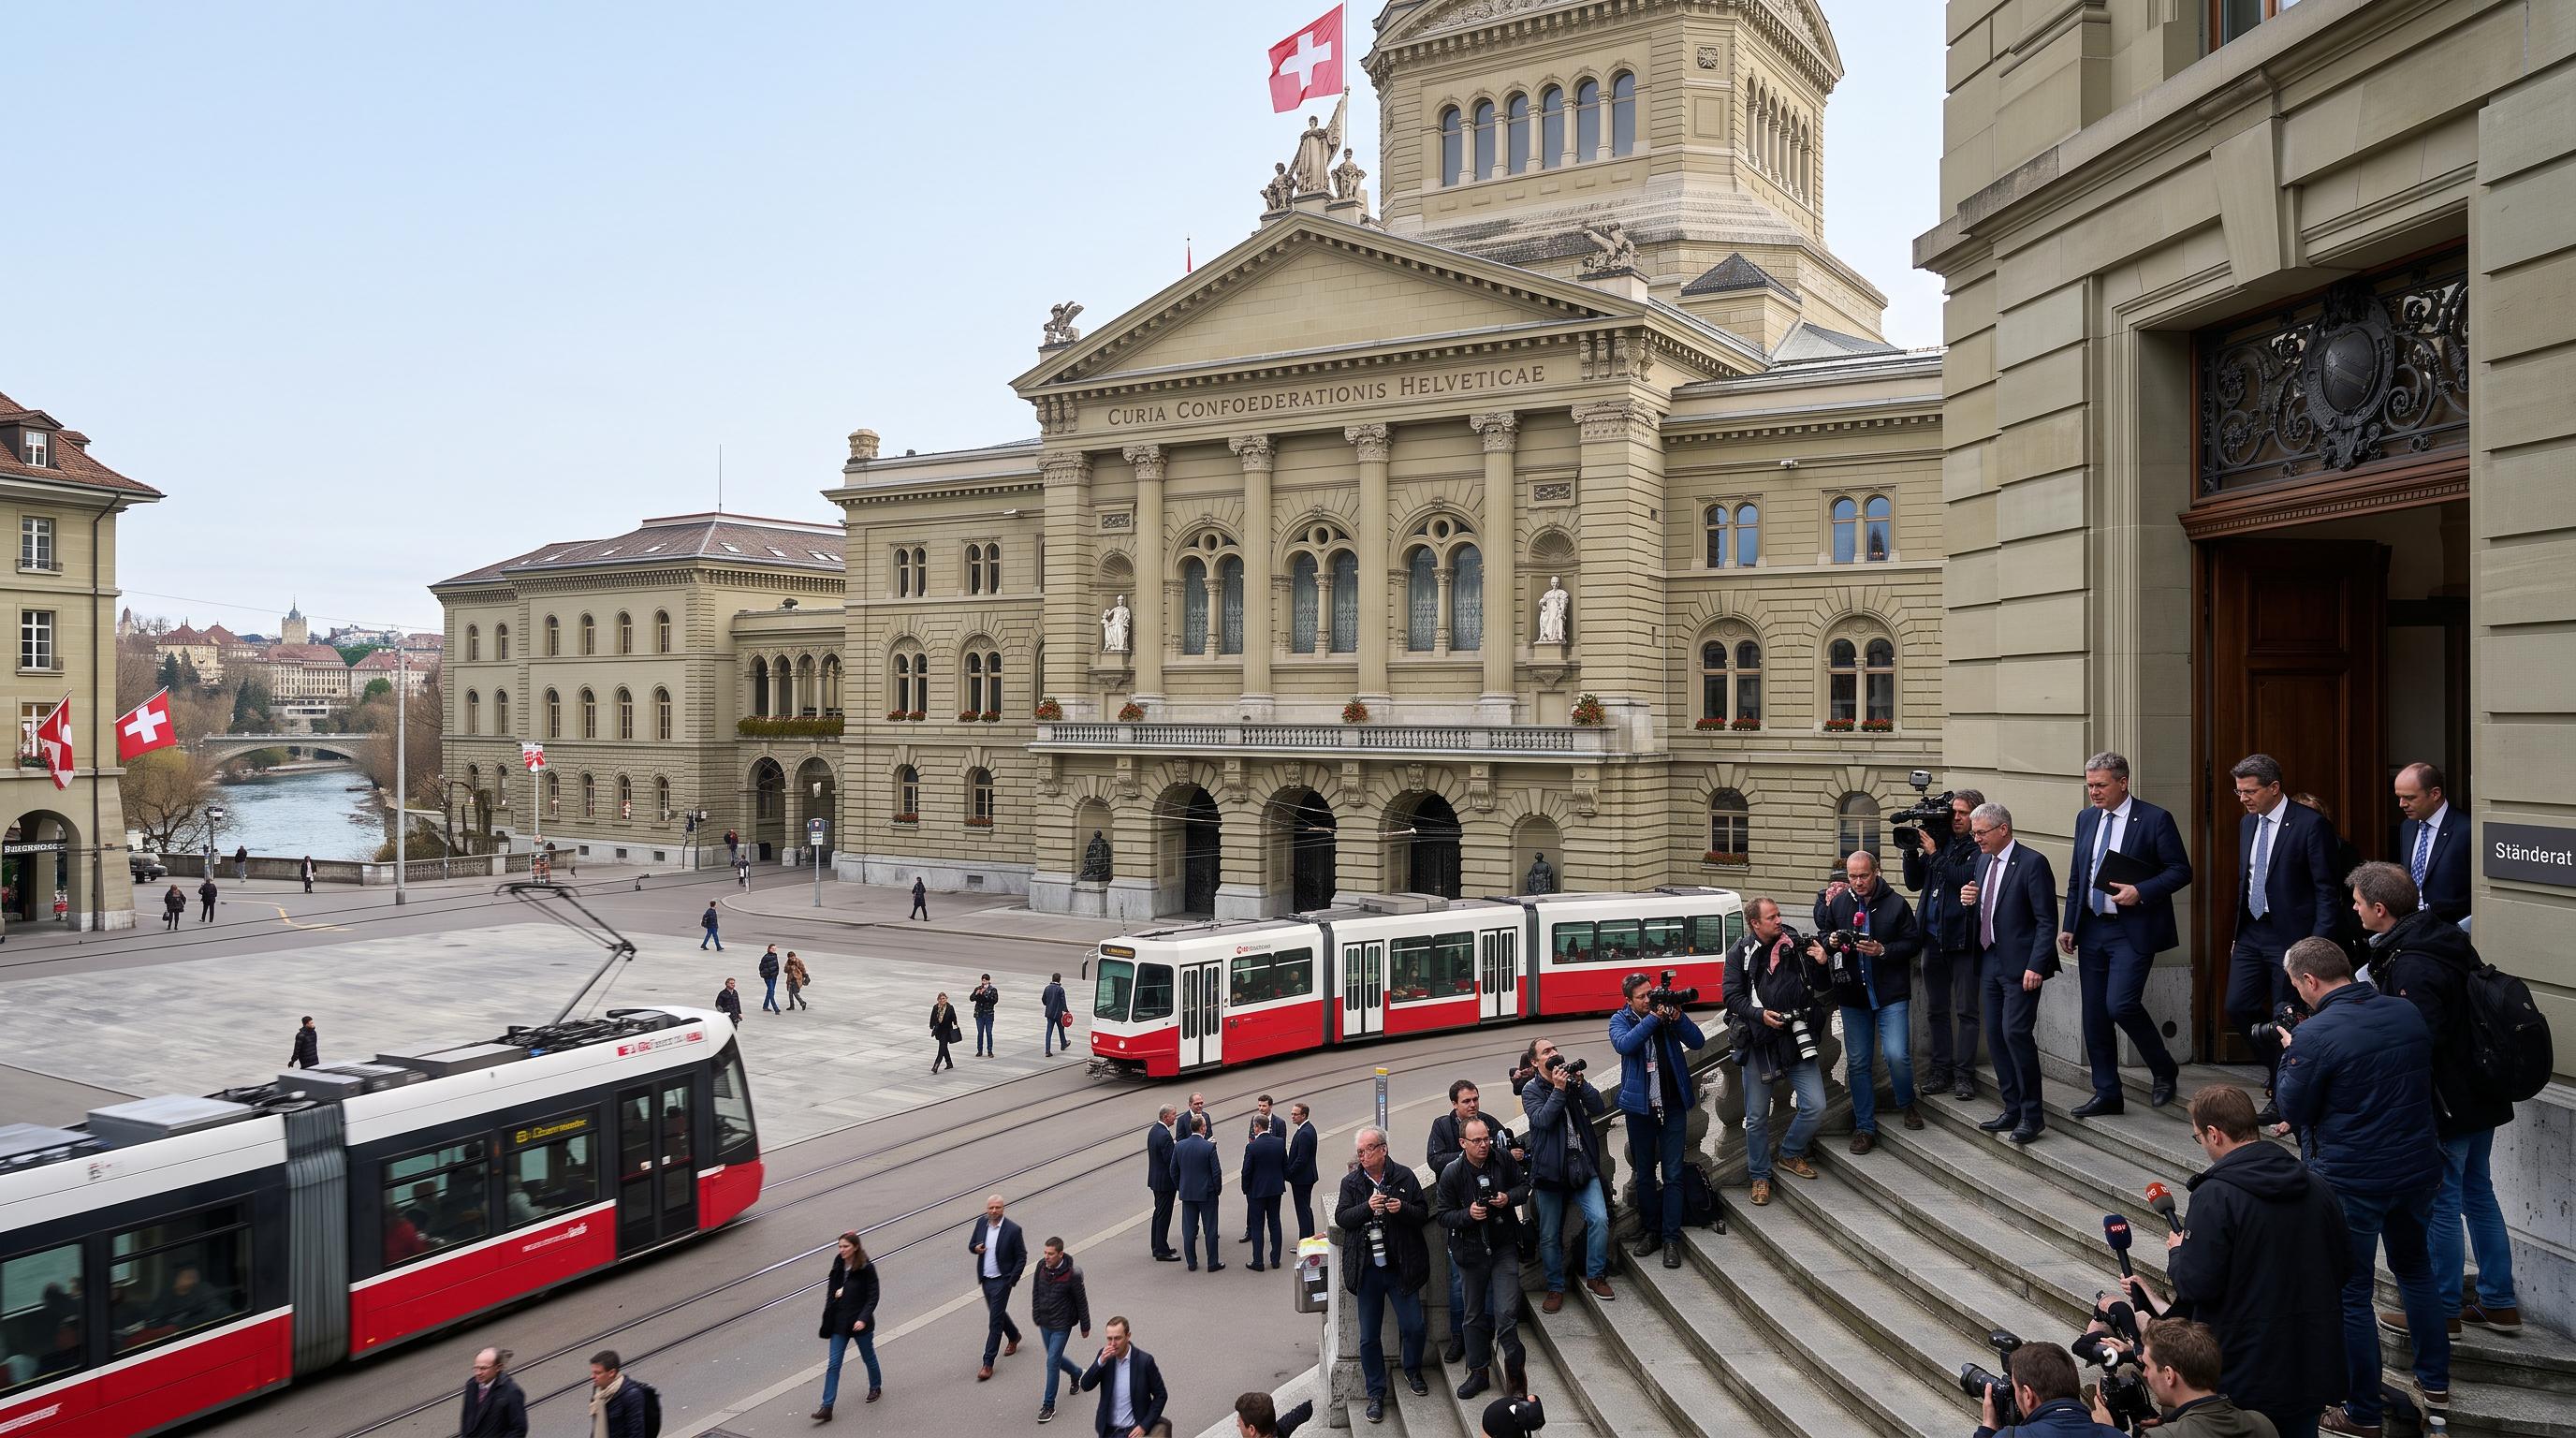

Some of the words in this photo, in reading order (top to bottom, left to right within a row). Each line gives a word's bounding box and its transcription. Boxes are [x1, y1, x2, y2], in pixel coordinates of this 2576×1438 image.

[1107, 405, 1167, 426] CURIA
[1399, 365, 1545, 396] HELVETICAE
[2495, 842, 2573, 866] Ständerat
